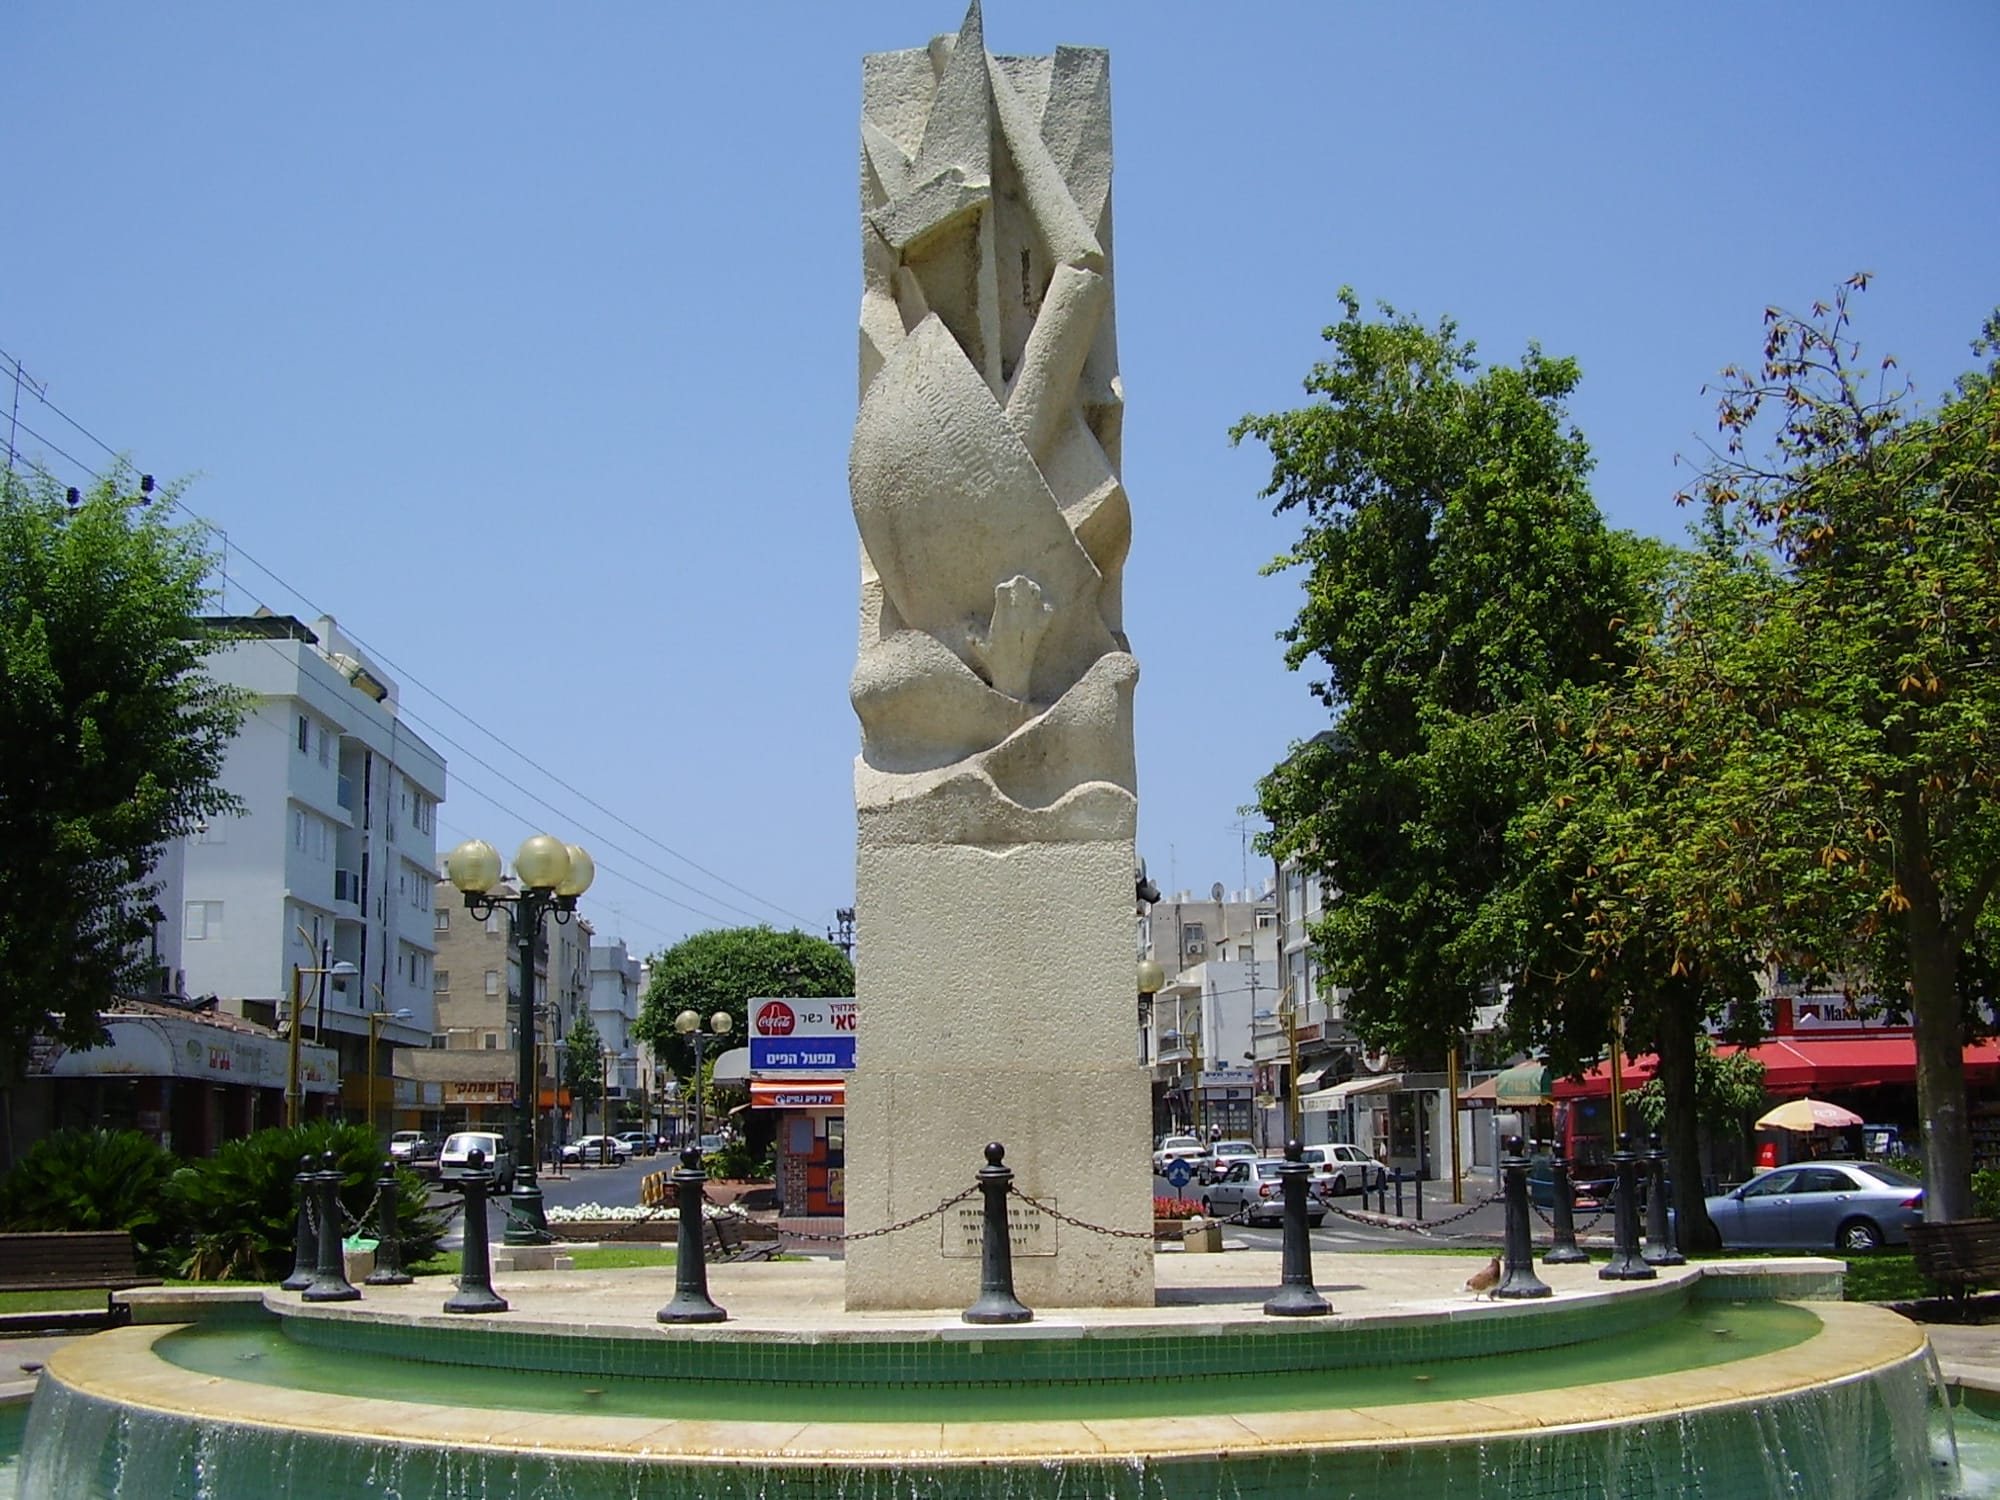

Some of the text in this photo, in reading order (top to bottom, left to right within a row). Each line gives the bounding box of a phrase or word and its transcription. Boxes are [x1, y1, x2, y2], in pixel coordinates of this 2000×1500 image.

[800, 1013, 823, 1023] כשר
[766, 1053, 798, 1065] הפיס
[800, 1052, 836, 1065] מפעל
